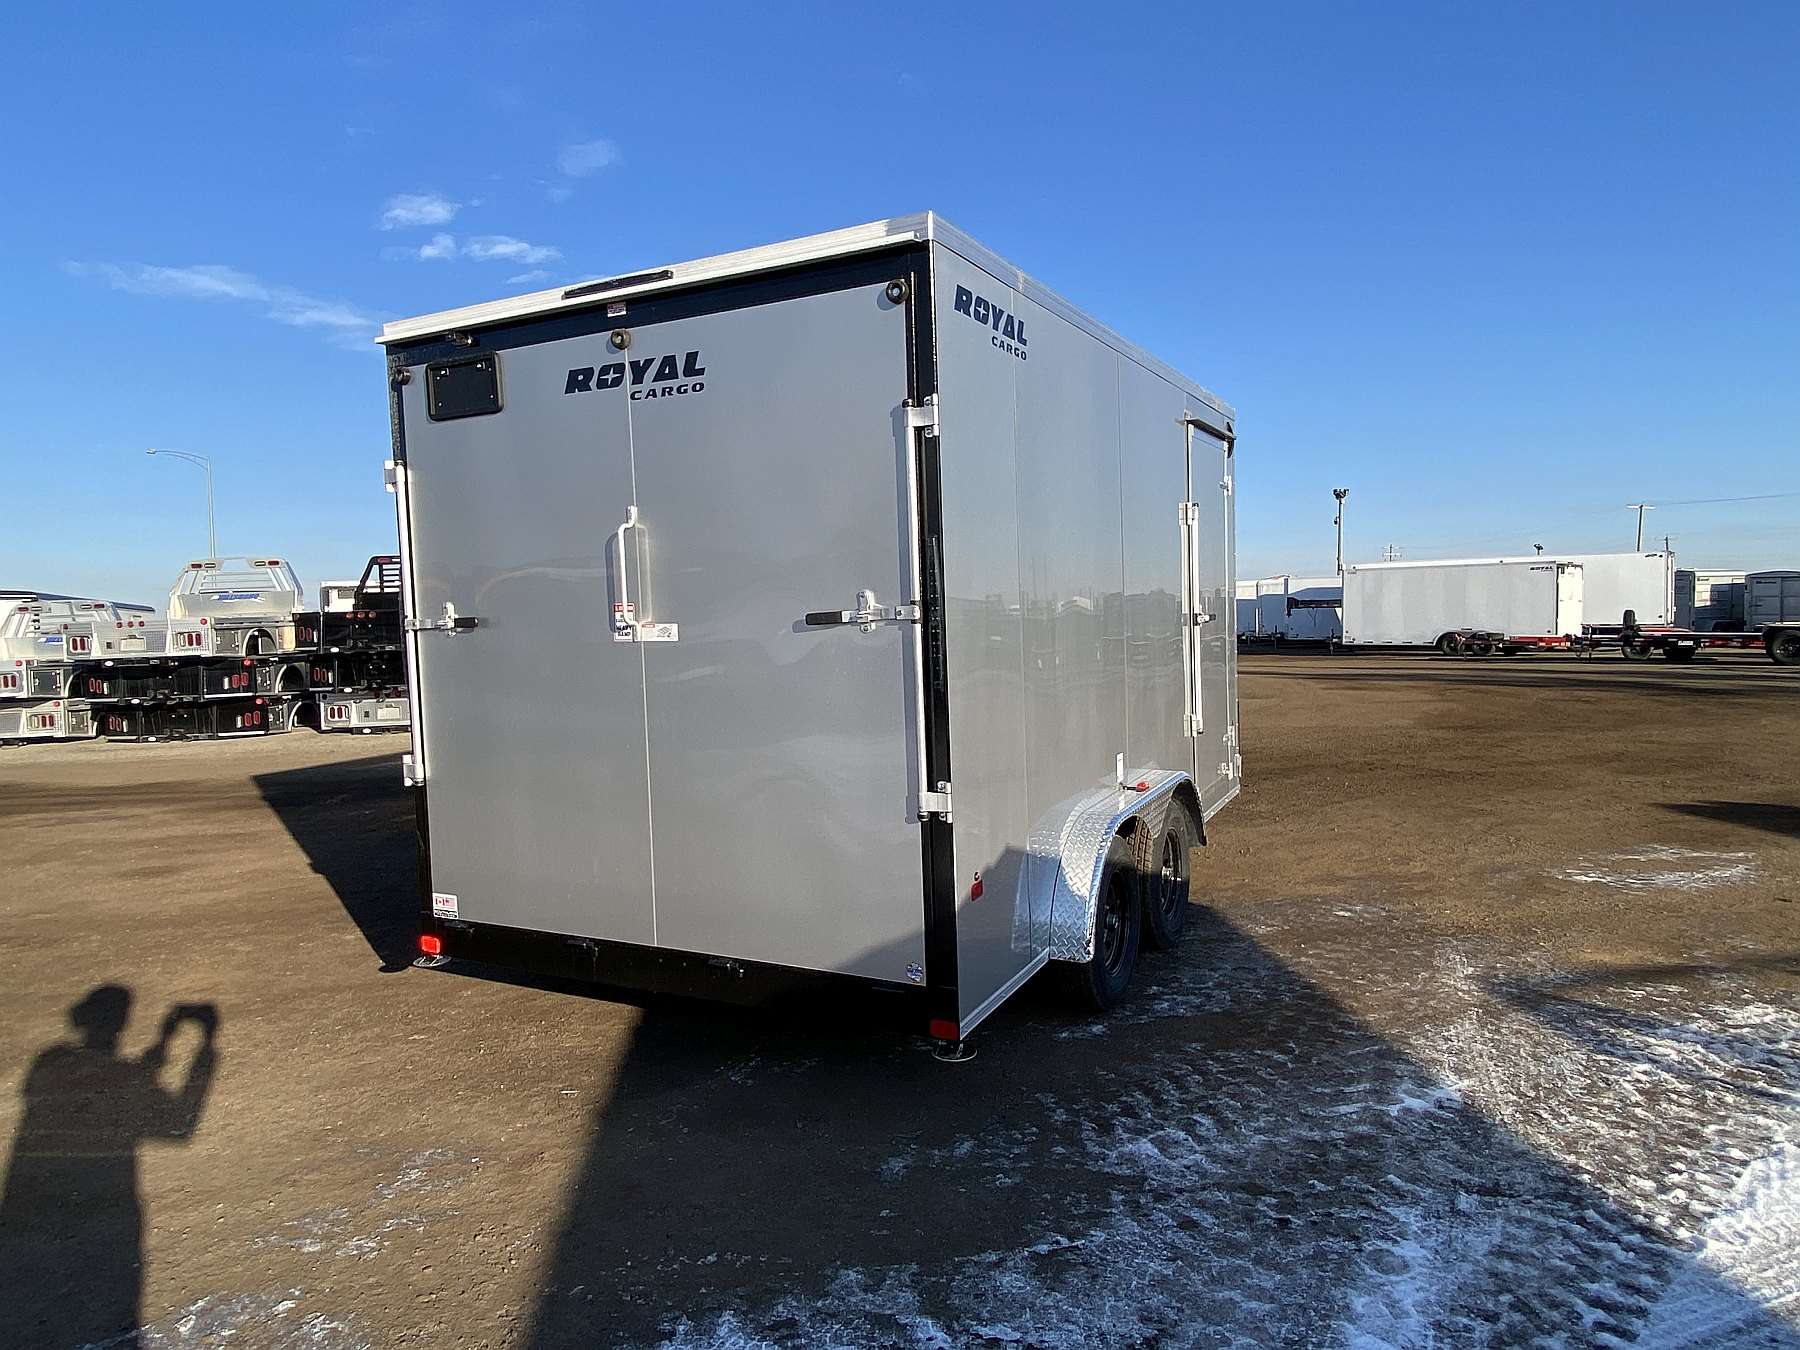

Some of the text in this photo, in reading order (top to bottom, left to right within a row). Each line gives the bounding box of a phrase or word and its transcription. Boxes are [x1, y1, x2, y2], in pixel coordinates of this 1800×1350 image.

[954, 284, 1028, 346] ROYAL
[991, 336, 1027, 361] CARGO
[564, 350, 706, 395] ROYAL
[630, 381, 705, 401] CARGO
